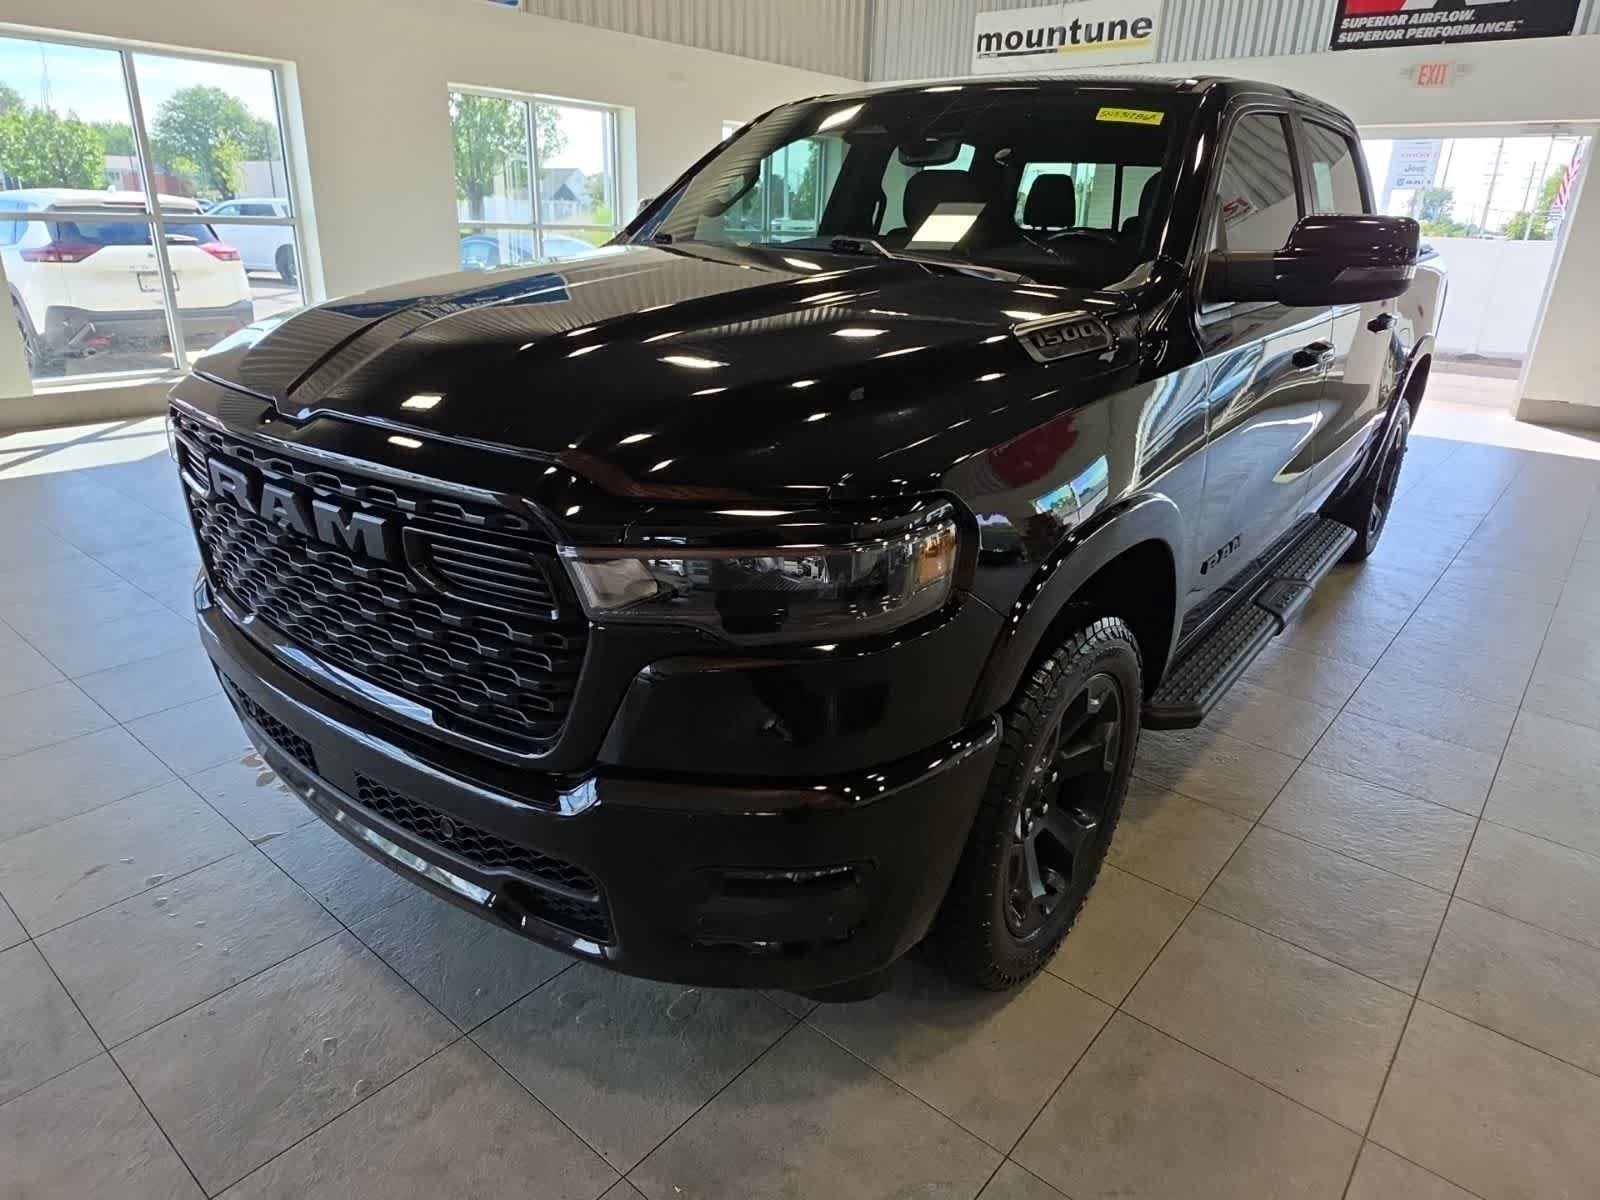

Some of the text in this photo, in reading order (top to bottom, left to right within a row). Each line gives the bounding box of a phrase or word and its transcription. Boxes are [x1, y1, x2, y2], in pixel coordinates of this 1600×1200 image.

[1341, 8, 1475, 29] SUPERIOR AIRFLOW.
[977, 16, 1153, 52] mountune
[1338, 28, 1406, 43] SUPERIOR
[1417, 63, 1449, 86] EXIT
[1036, 321, 1095, 348] 1500
[208, 456, 389, 561] RAM
